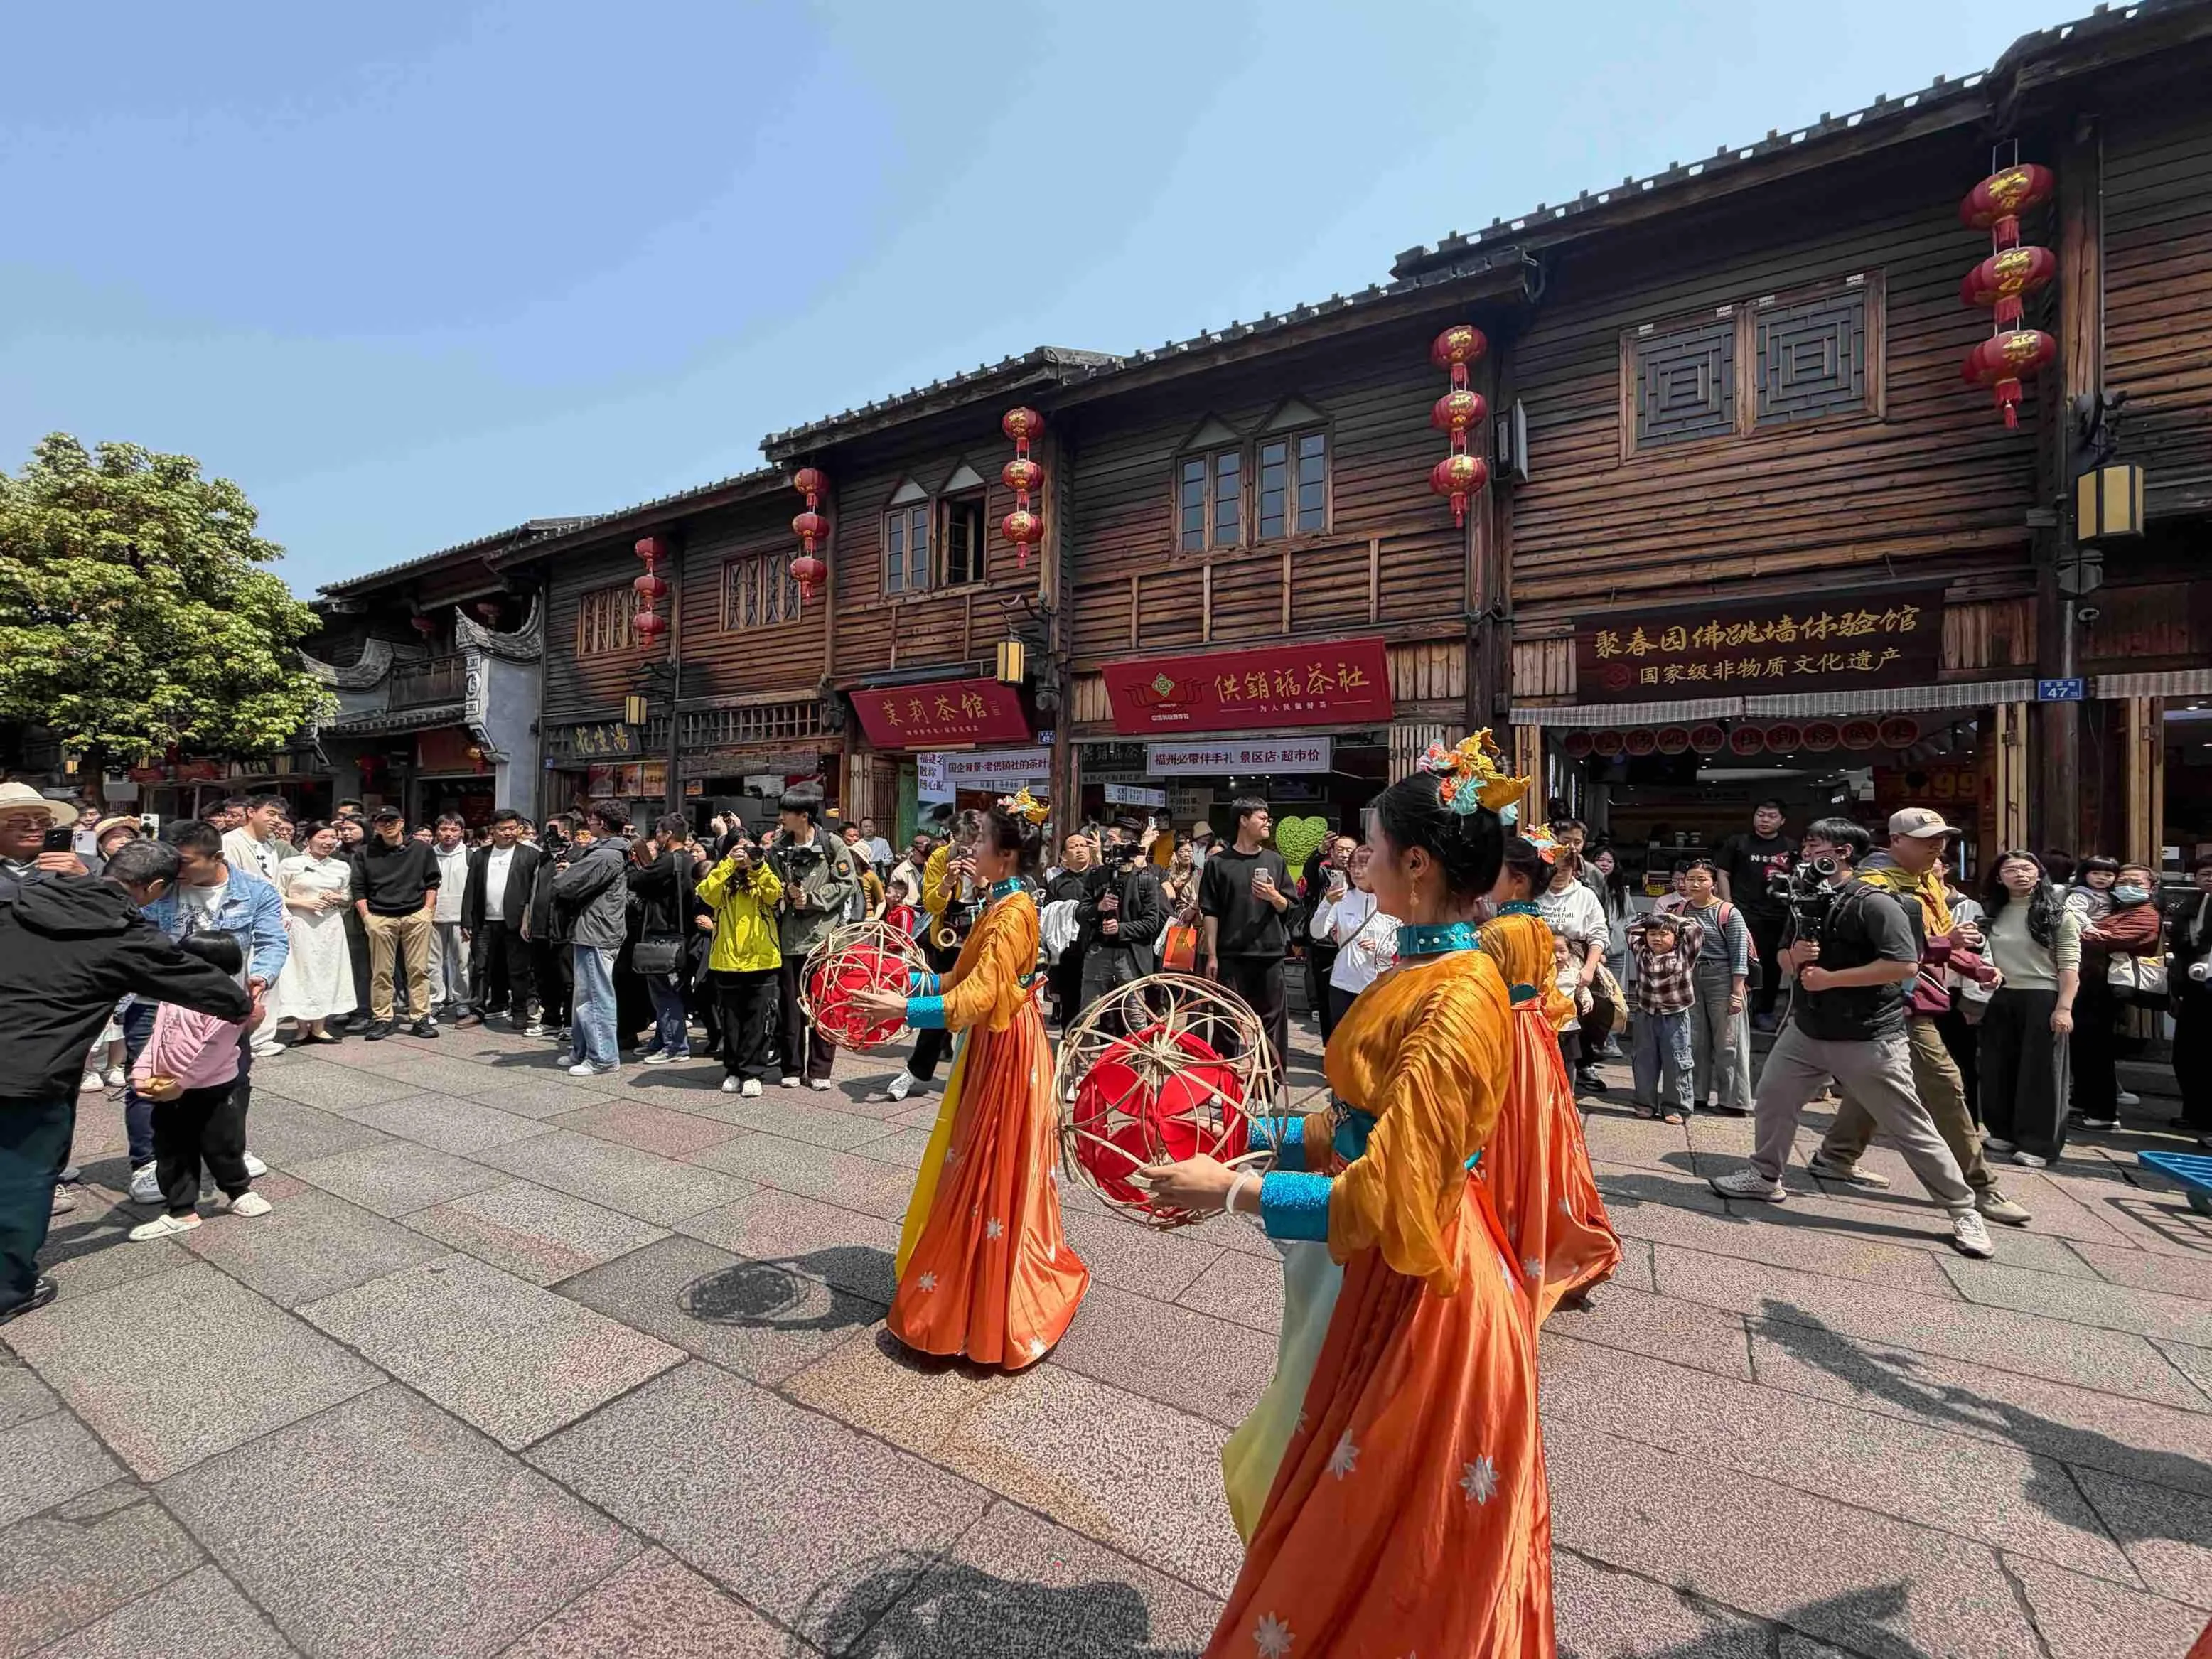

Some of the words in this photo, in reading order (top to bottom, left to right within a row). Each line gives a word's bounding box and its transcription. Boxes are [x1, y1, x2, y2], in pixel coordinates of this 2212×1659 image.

[1594, 603, 1921, 659] 聚春园佛跳墙体验馆
[1214, 662, 1371, 703] 供銷福茶社
[1640, 646, 1903, 685] 国家级非物质文化遗产
[882, 692, 987, 726] 茉莉茶馆
[2047, 687, 2068, 698] 47
[1154, 751, 1235, 767] 福州必带伴手礼
[1240, 749, 1320, 764] 景区店·超市价
